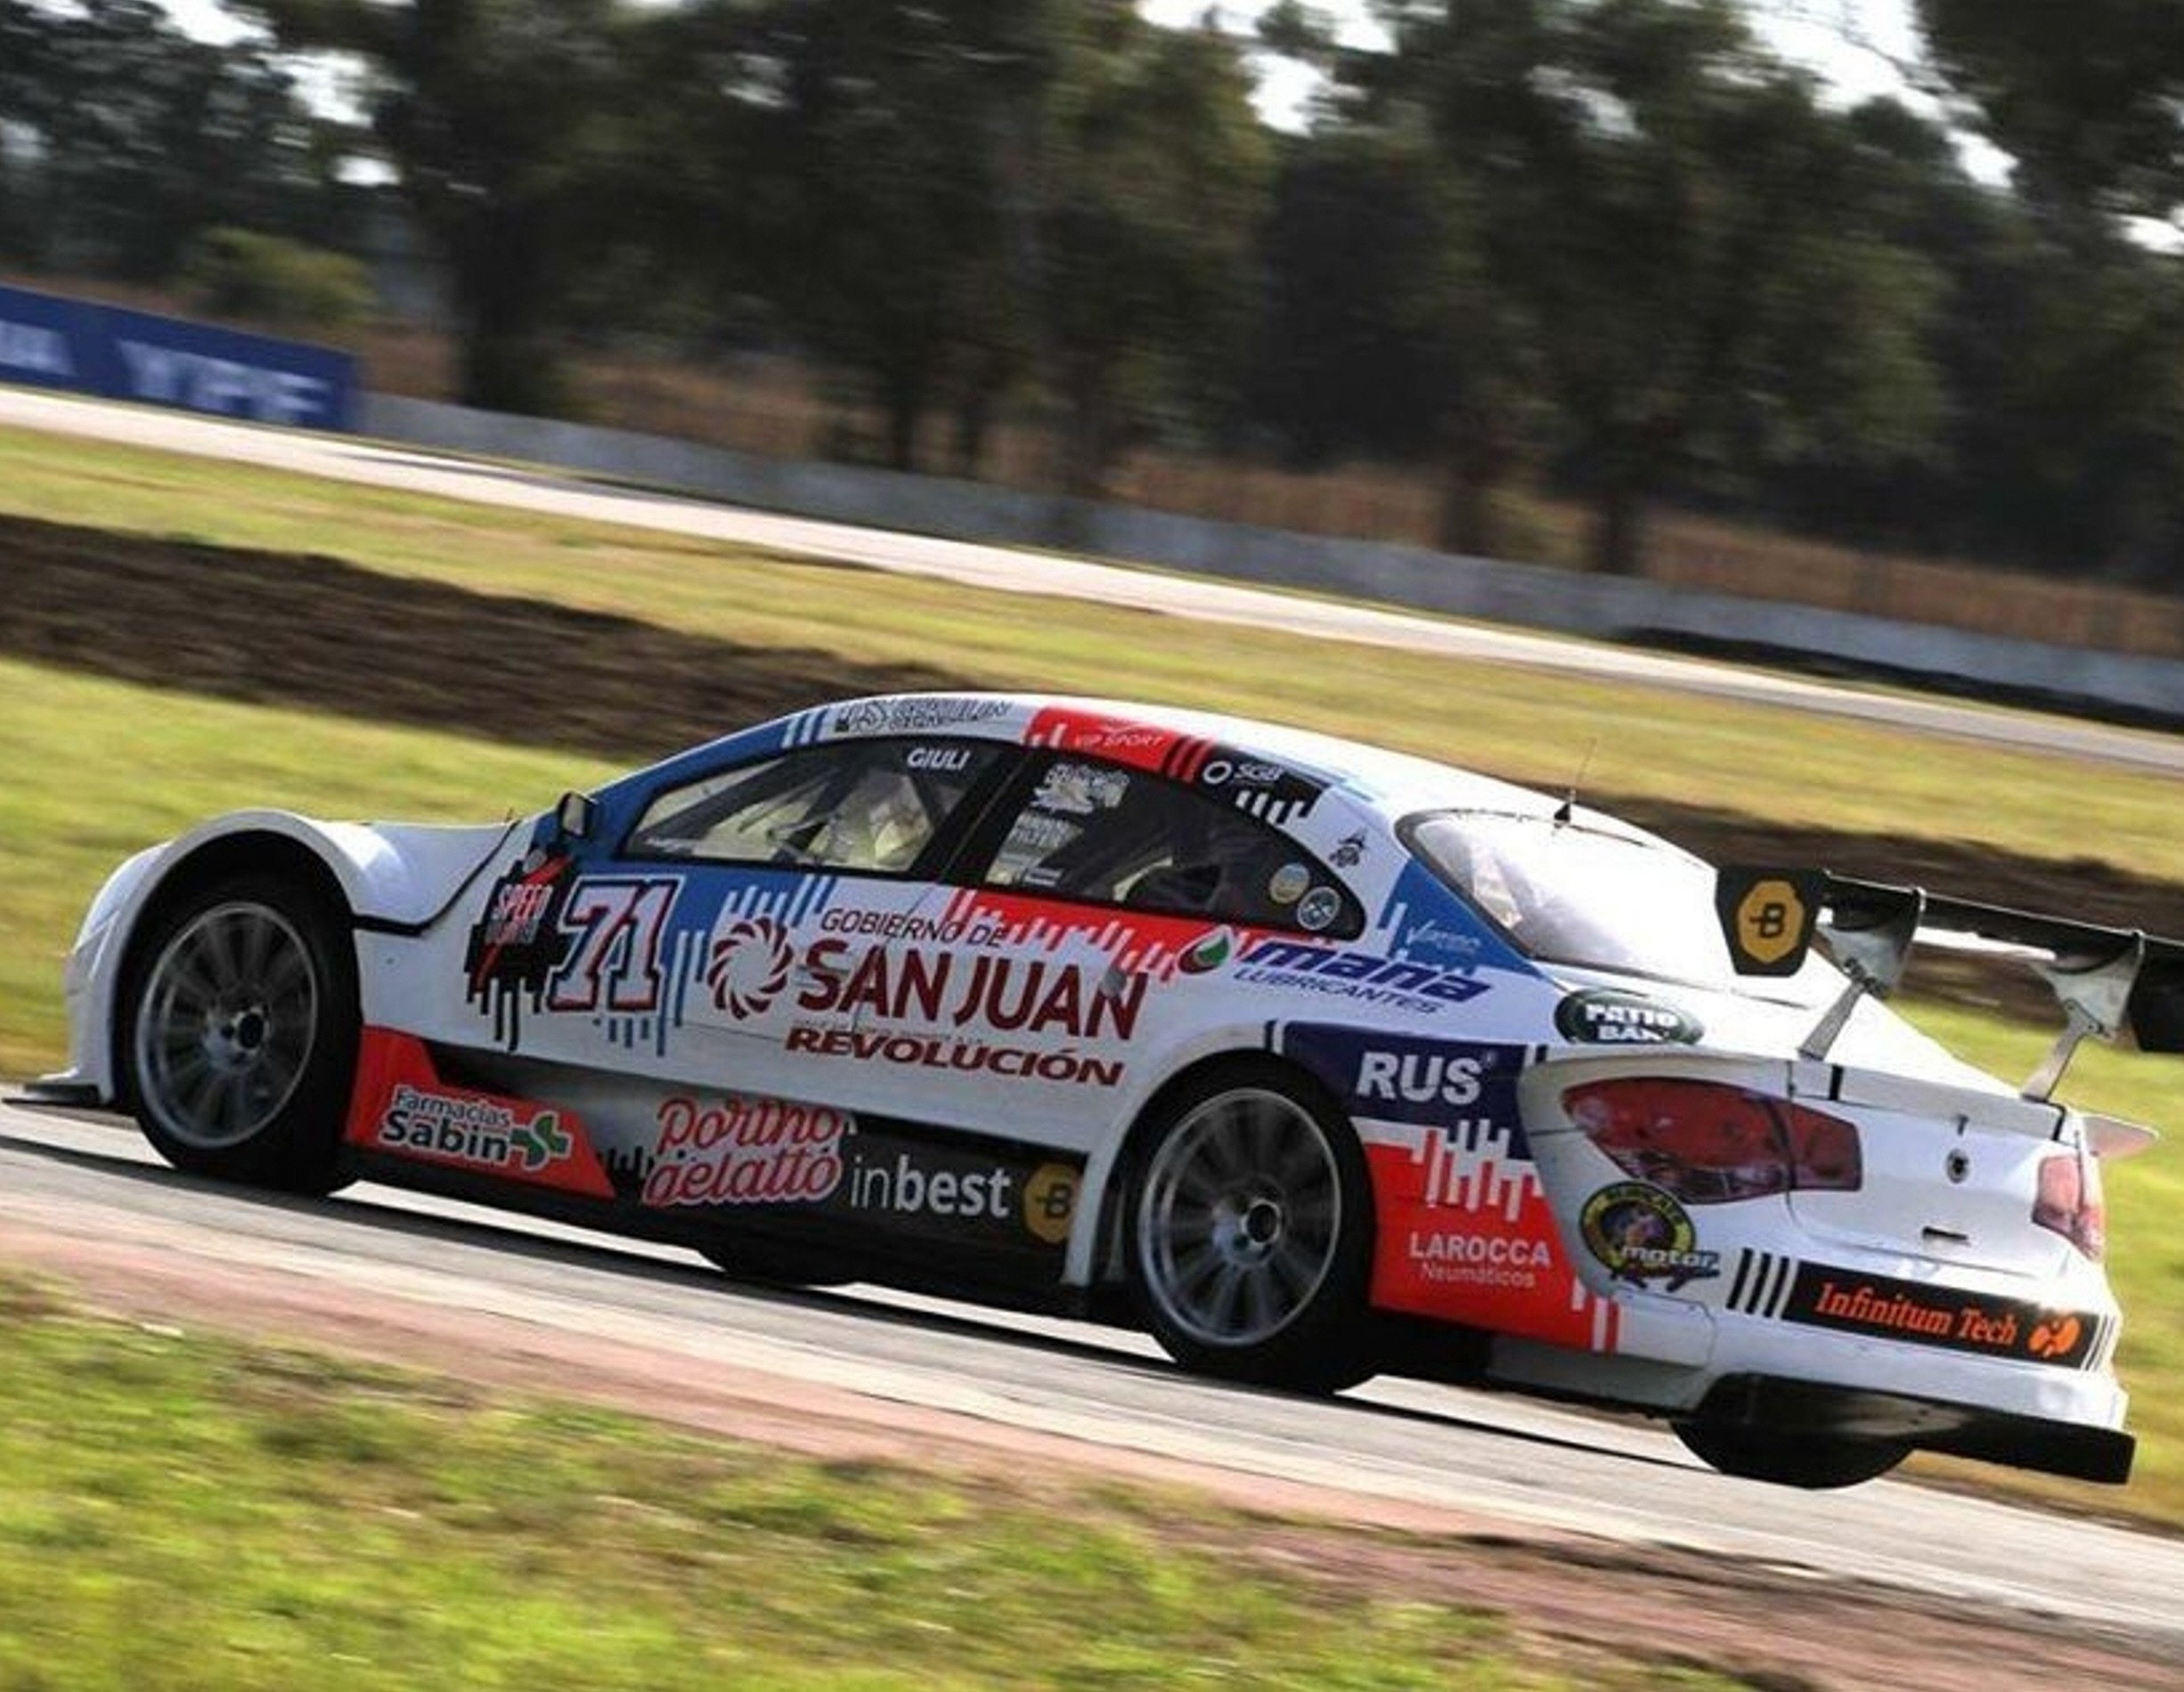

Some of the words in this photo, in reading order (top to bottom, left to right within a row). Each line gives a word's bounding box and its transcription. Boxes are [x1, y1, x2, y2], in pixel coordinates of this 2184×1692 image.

[907, 747, 971, 771] GIULI
[1104, 733, 1165, 748] SPORT
[546, 874, 688, 1015] 71
[820, 907, 962, 945] GOBIERNO
[966, 920, 1008, 949] DE
[796, 936, 952, 1022] SAN
[954, 956, 1150, 1041] JUAN
[1234, 967, 1449, 1015] LUBRICANTES
[784, 1027, 1125, 1086] REVOLUCIÓN
[1355, 1051, 1485, 1106] RUS
[395, 1086, 511, 1127] Farmacias
[382, 1110, 509, 1162] Sabin
[1409, 1231, 1552, 1268] LAROCCA
[1815, 1282, 1954, 1335] Infinitum
[1959, 1307, 2021, 1346] Tech
